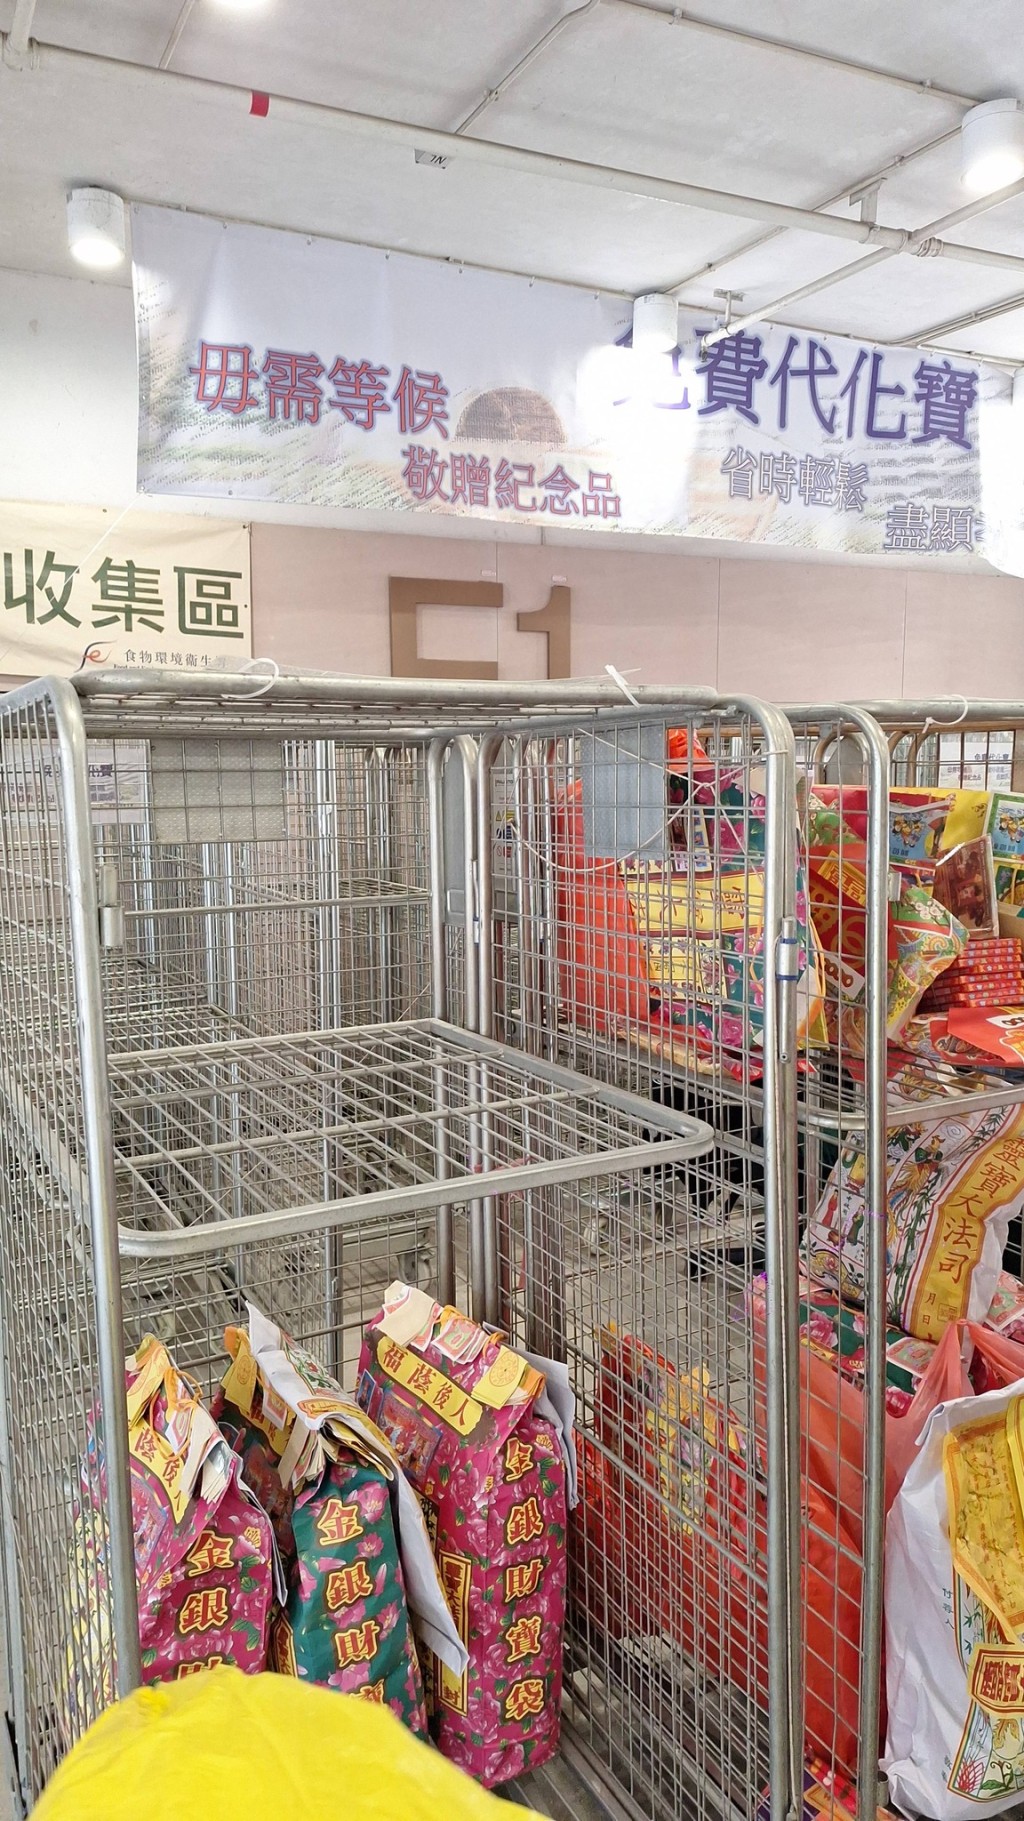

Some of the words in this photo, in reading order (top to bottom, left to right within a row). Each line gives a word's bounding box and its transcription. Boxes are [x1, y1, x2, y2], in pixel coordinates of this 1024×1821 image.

[189, 341, 450, 440] 毋需等候
[402, 444, 622, 519] 敬贈紀念品
[720, 445, 870, 513] 省時輕鬆
[883, 502, 987, 553] 盡顯
[3, 547, 244, 639] 收集區
[383, 1343, 469, 1427] 福蔭後人
[505, 1437, 544, 1722] 金銀財寶袋
